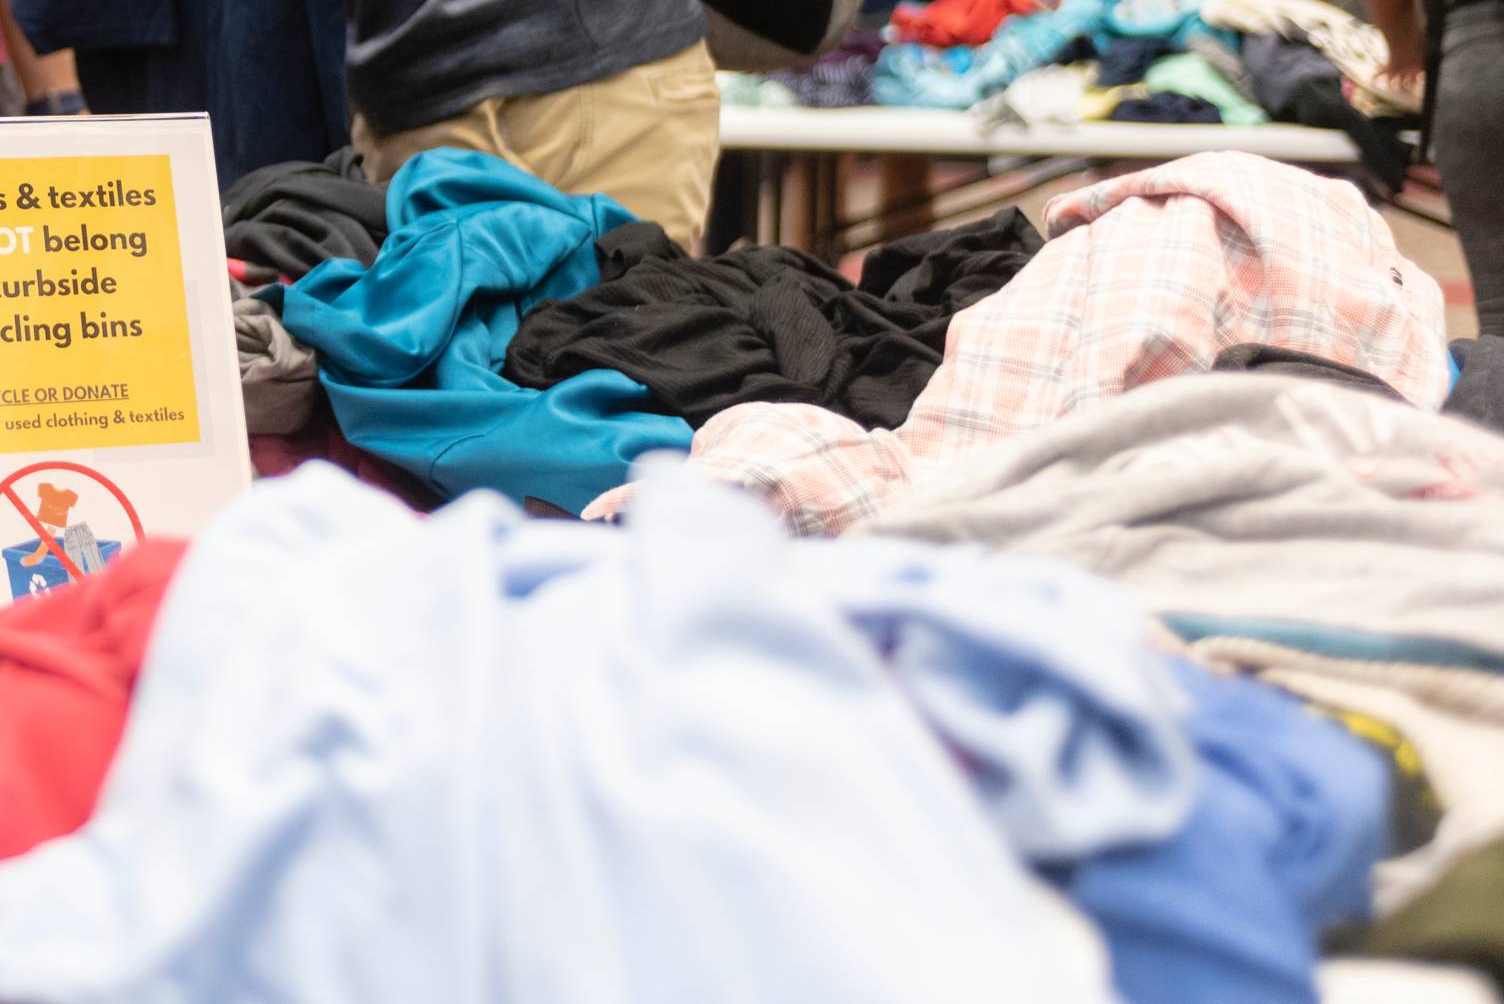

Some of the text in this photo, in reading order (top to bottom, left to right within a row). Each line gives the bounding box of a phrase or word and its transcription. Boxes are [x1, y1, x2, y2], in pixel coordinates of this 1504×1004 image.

[17, 183, 42, 210] &
[47, 180, 157, 209] textiles
[42, 224, 148, 258] belong
[81, 311, 143, 339] bins
[34, 387, 58, 403] OR
[63, 384, 129, 401] DONATE
[5, 413, 41, 430] used
[46, 411, 109, 430] clothing
[113, 410, 125, 424] &
[129, 407, 185, 422] textiles
